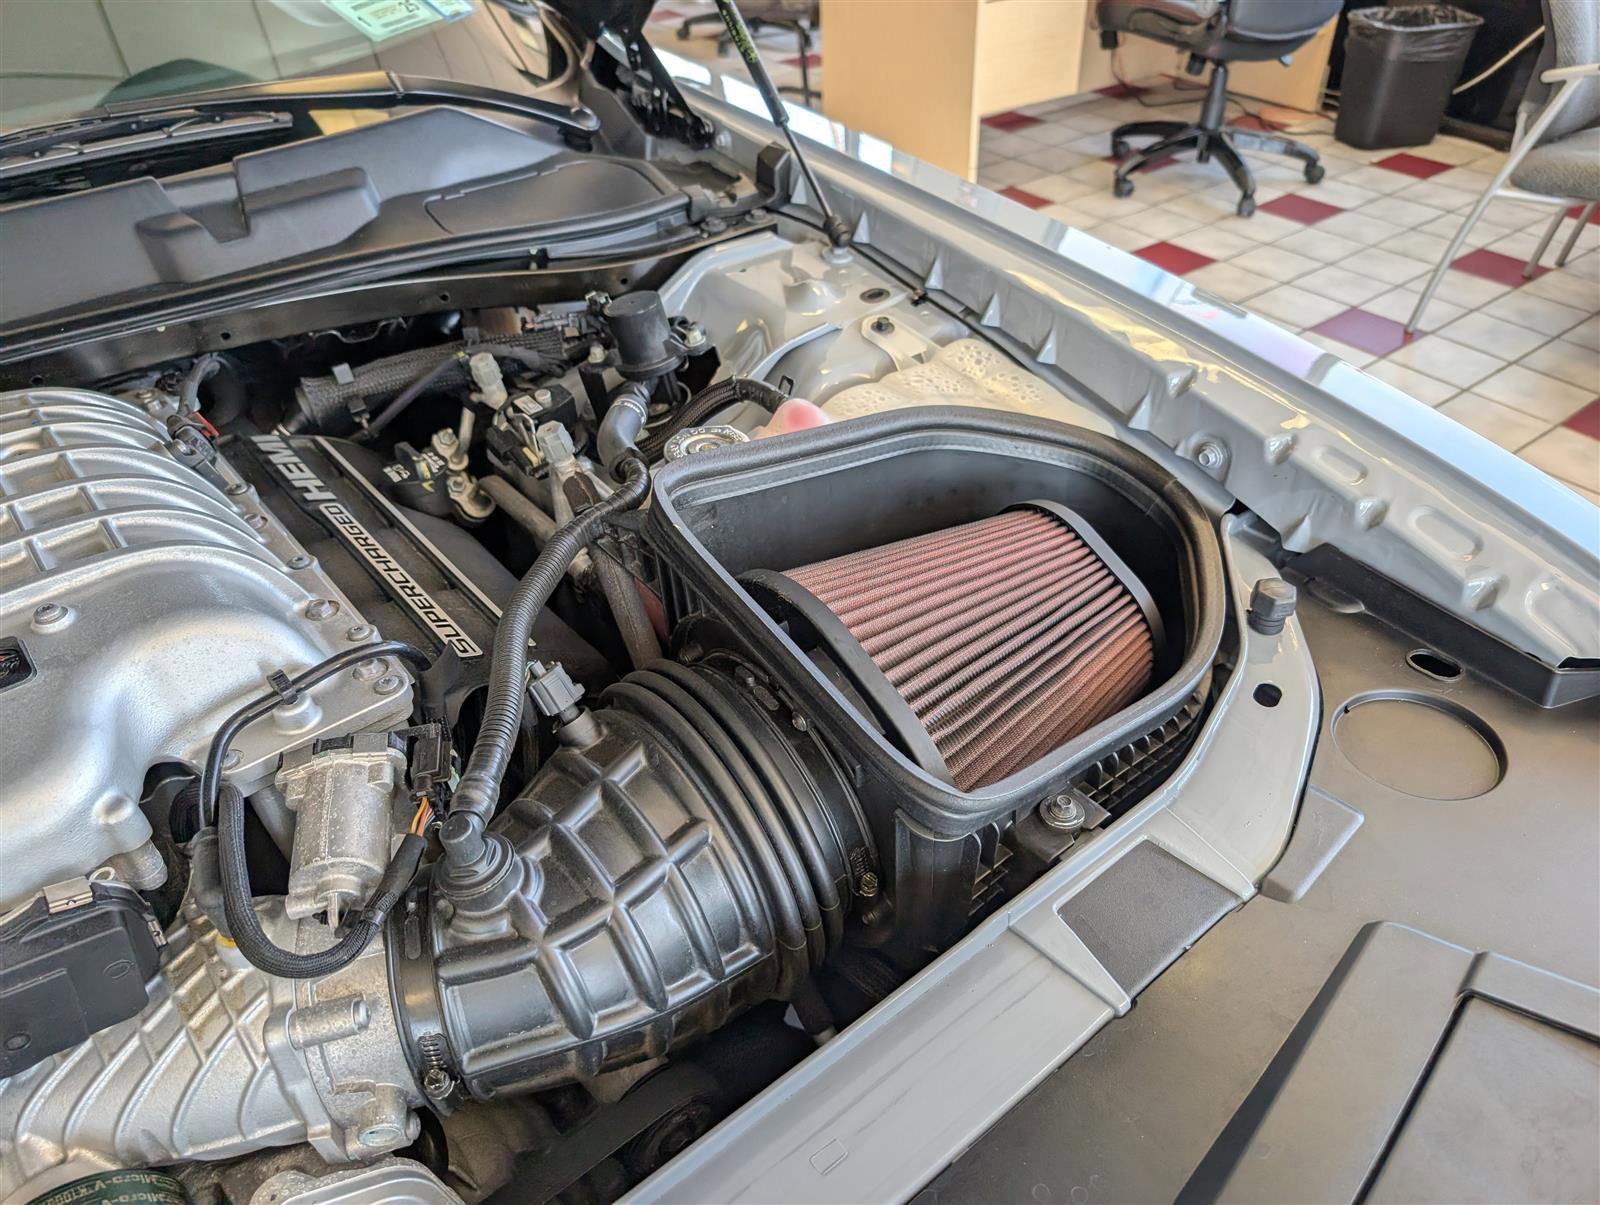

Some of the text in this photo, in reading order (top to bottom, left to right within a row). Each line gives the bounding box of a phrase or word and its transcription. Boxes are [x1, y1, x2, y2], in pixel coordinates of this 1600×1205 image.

[251, 434, 478, 655] SUPERCHARGED HEMI
[95, 1174, 157, 1191] Micro-V
